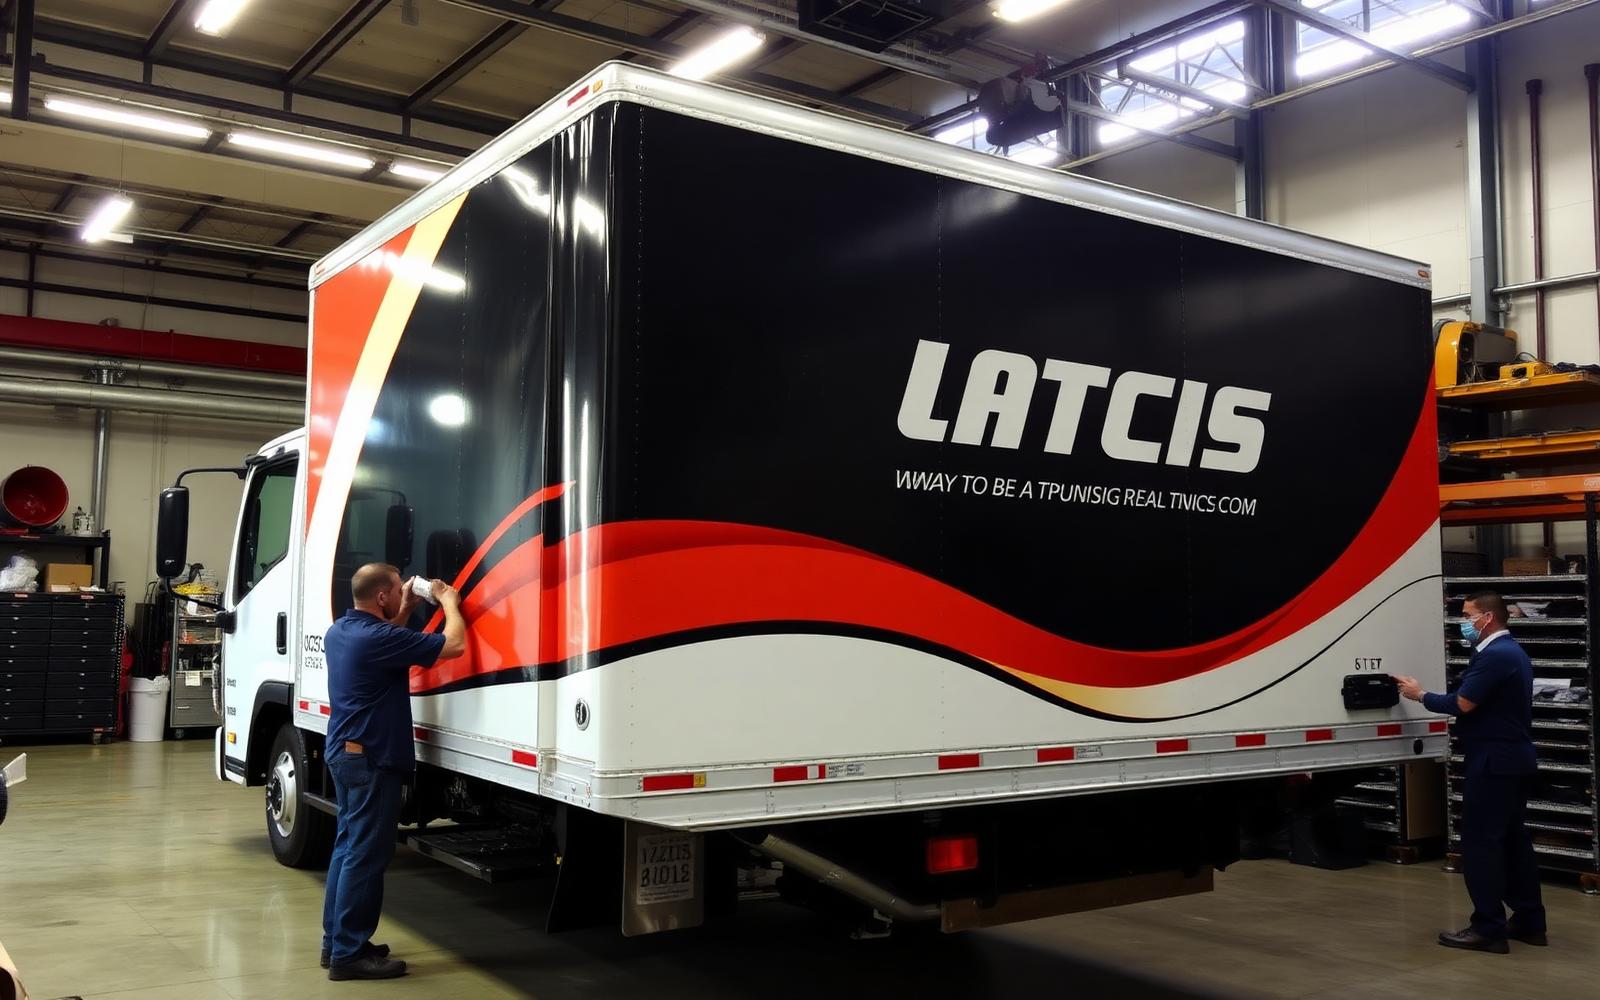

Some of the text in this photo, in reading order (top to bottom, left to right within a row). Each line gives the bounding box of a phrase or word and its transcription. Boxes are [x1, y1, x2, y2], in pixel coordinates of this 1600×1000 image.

[897, 339, 1272, 473] LATCIS
[962, 475, 988, 495] TO
[992, 478, 1017, 497] BE
[1019, 481, 1033, 499] A
[1123, 488, 1166, 508] REAL
